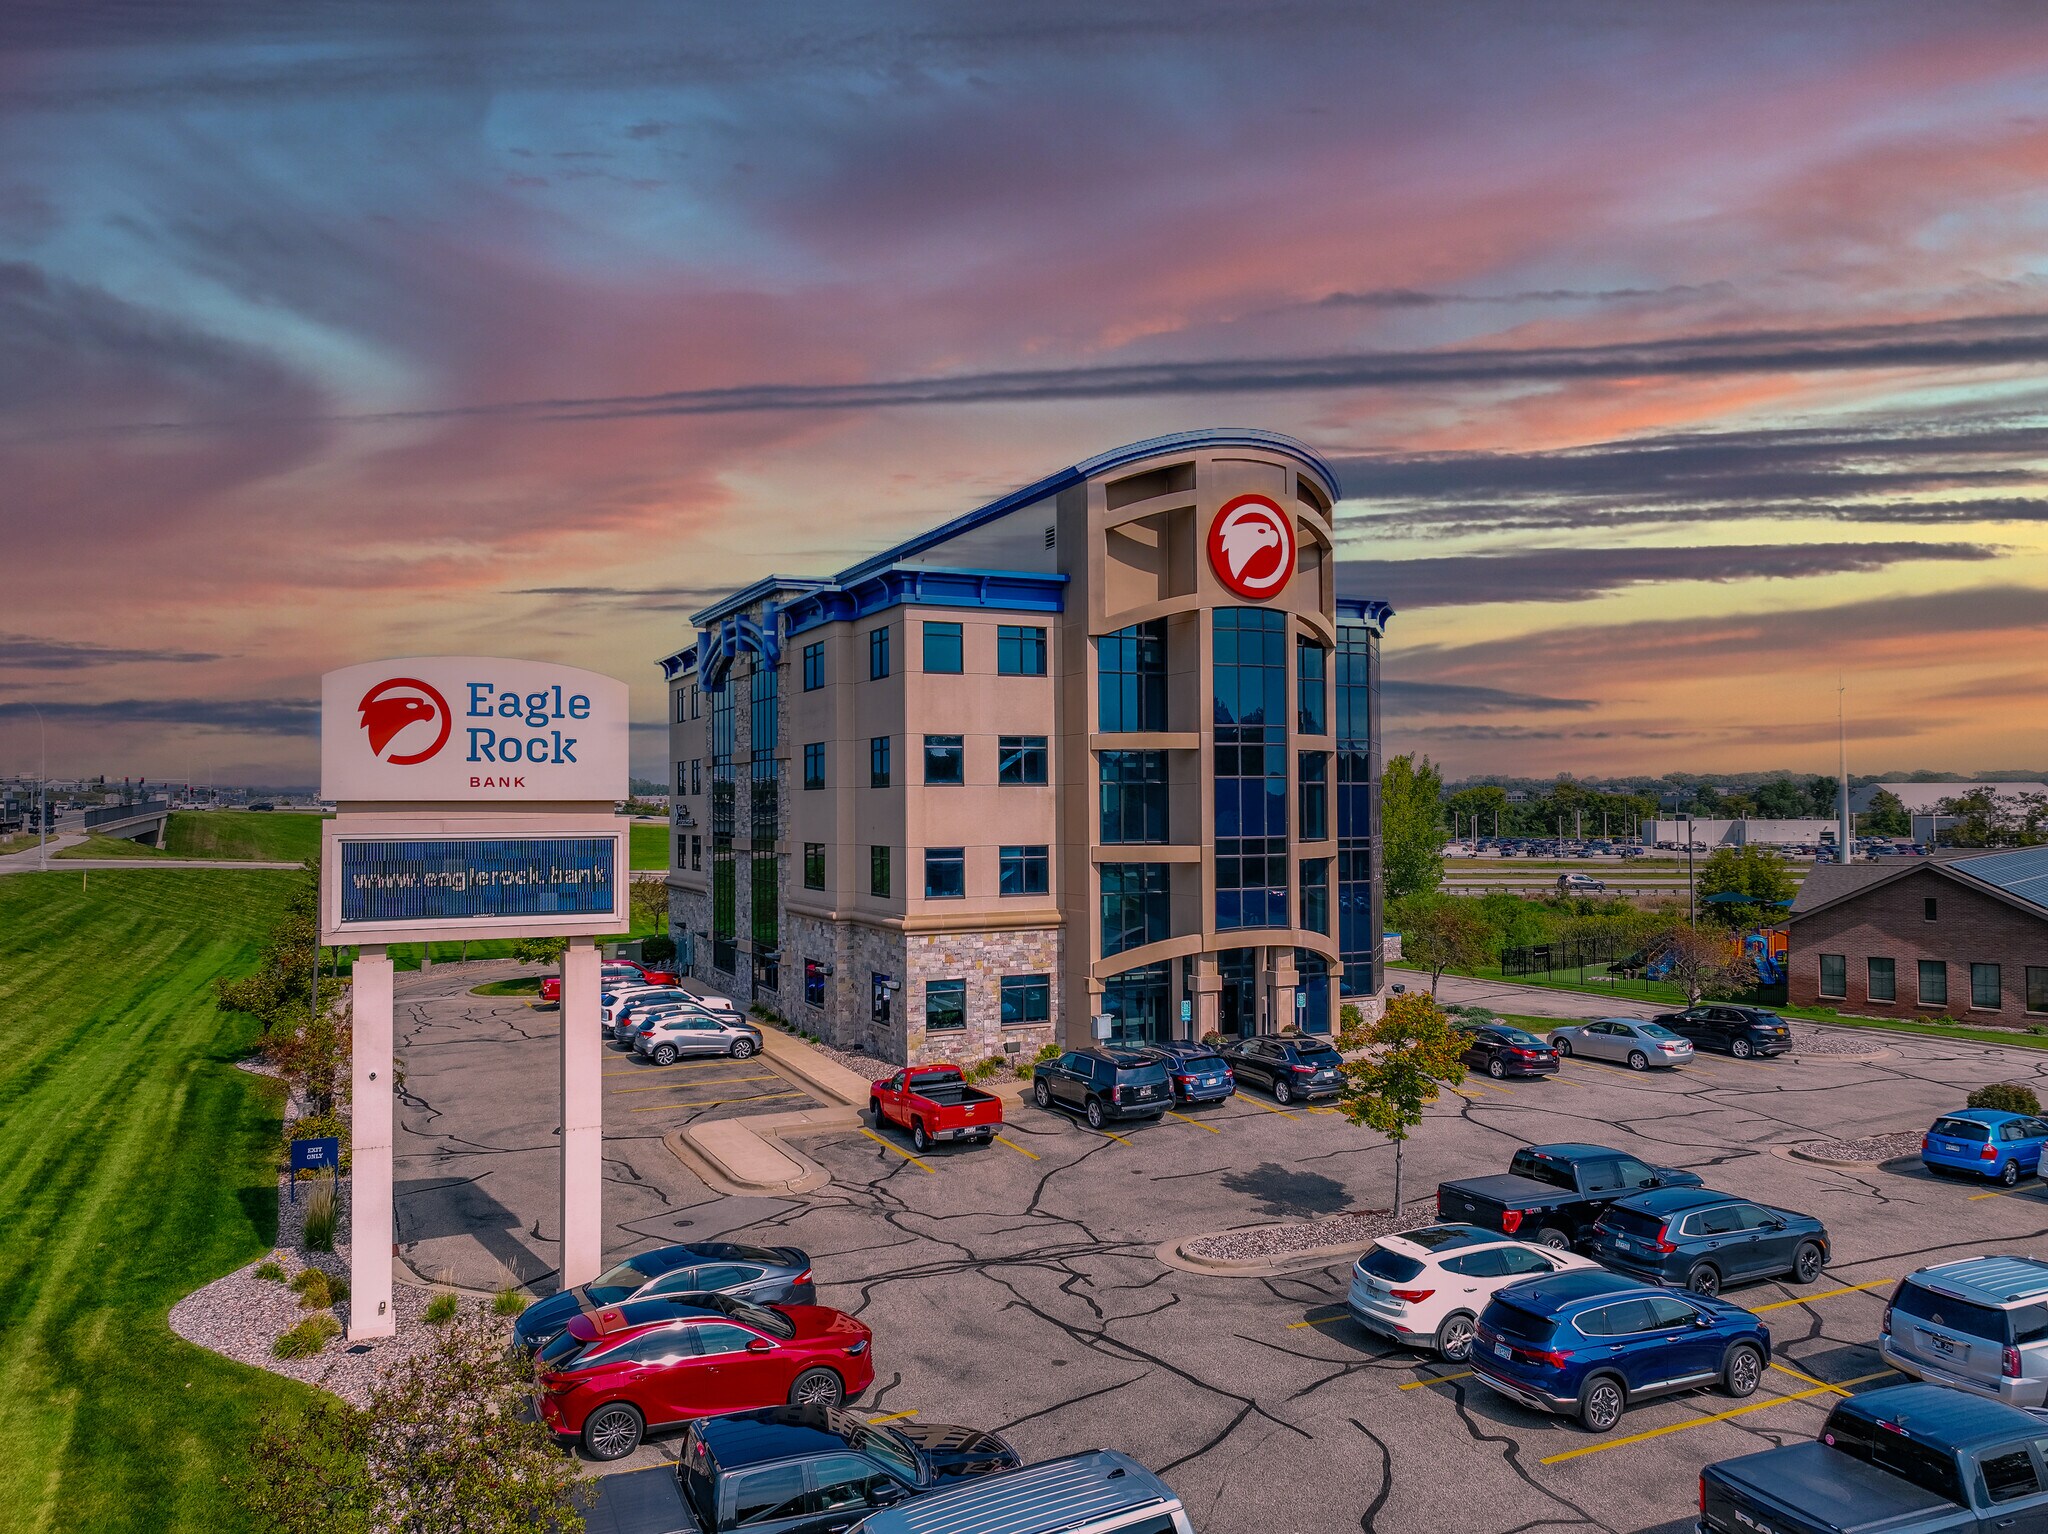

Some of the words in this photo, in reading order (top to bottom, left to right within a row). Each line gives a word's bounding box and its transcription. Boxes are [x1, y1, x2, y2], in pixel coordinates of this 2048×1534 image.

[466, 682, 591, 728] Eagle
[466, 727, 578, 764] Rock
[469, 776, 526, 788] BANK
[1734, 1509, 1781, 1534] RA
